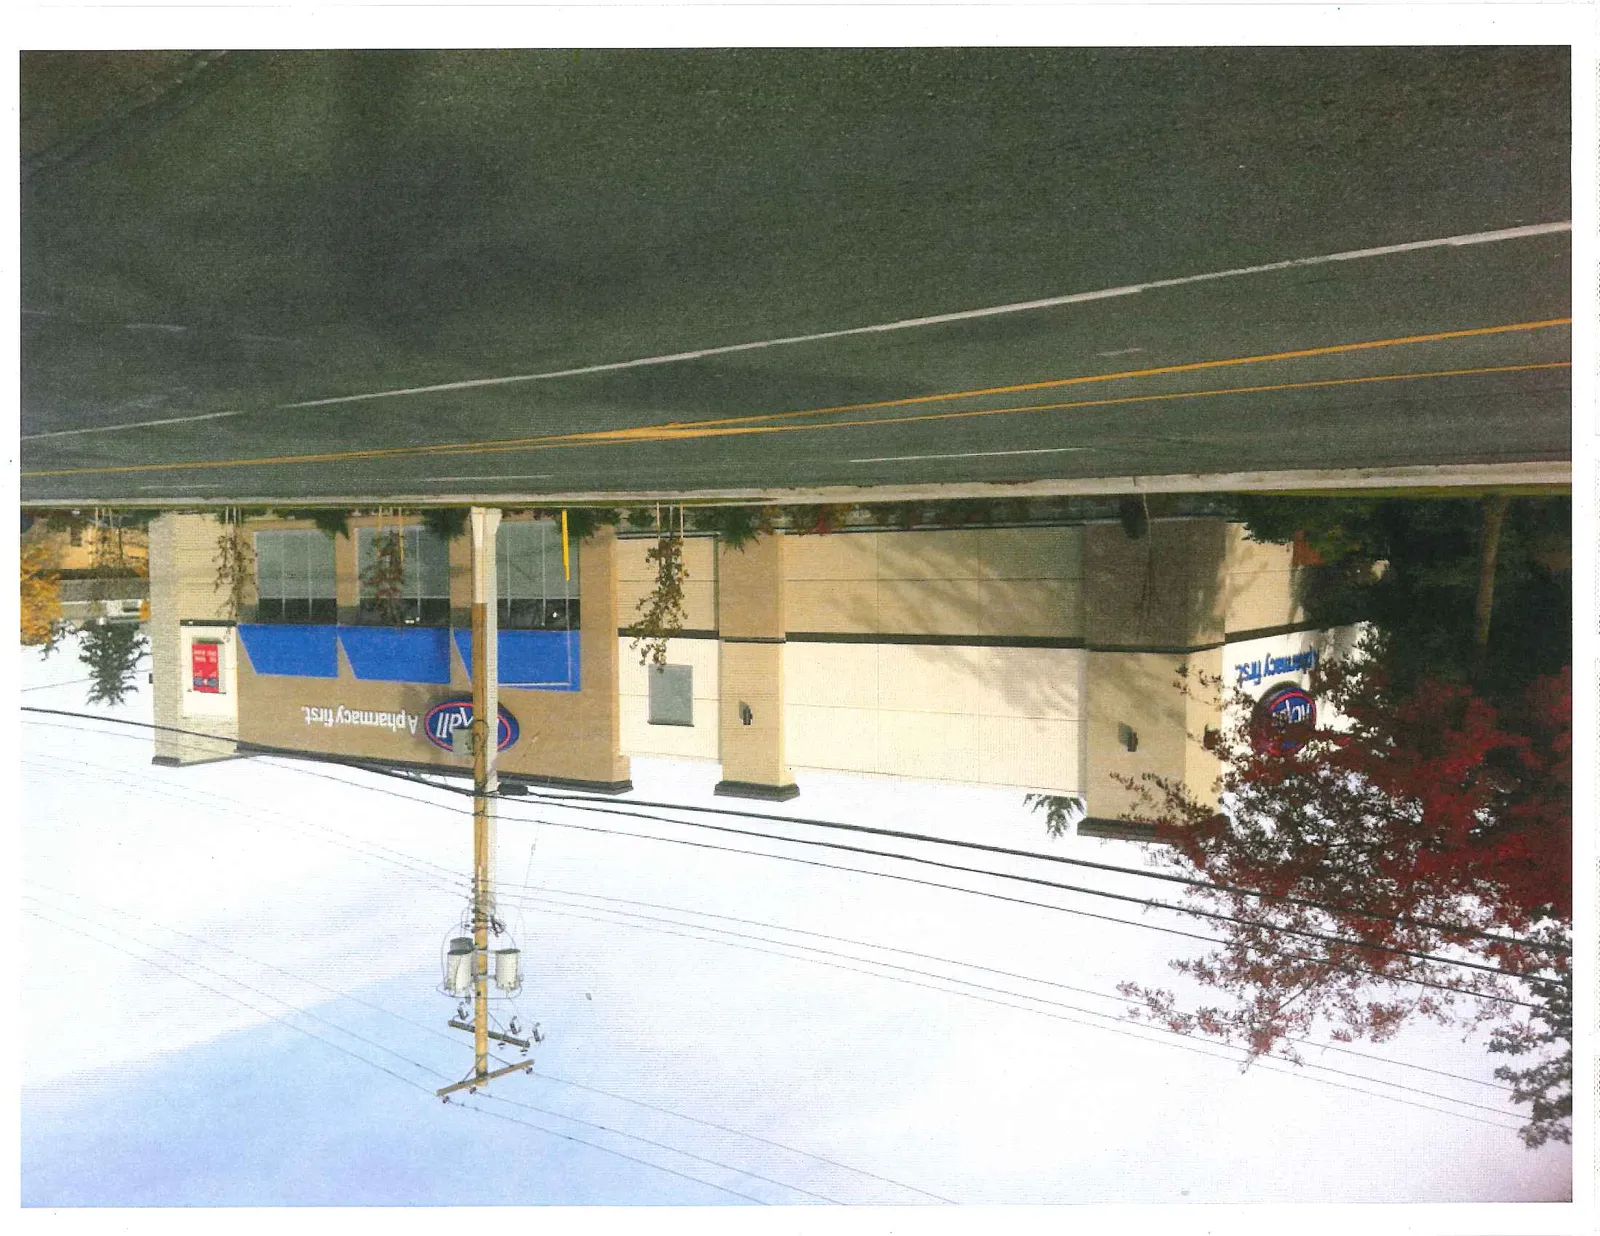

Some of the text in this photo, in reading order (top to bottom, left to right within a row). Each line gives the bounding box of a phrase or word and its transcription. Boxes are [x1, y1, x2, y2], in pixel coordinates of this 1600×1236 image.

[1263, 645, 1315, 678] pharmacy
[301, 704, 419, 735] A pharmacy first.
